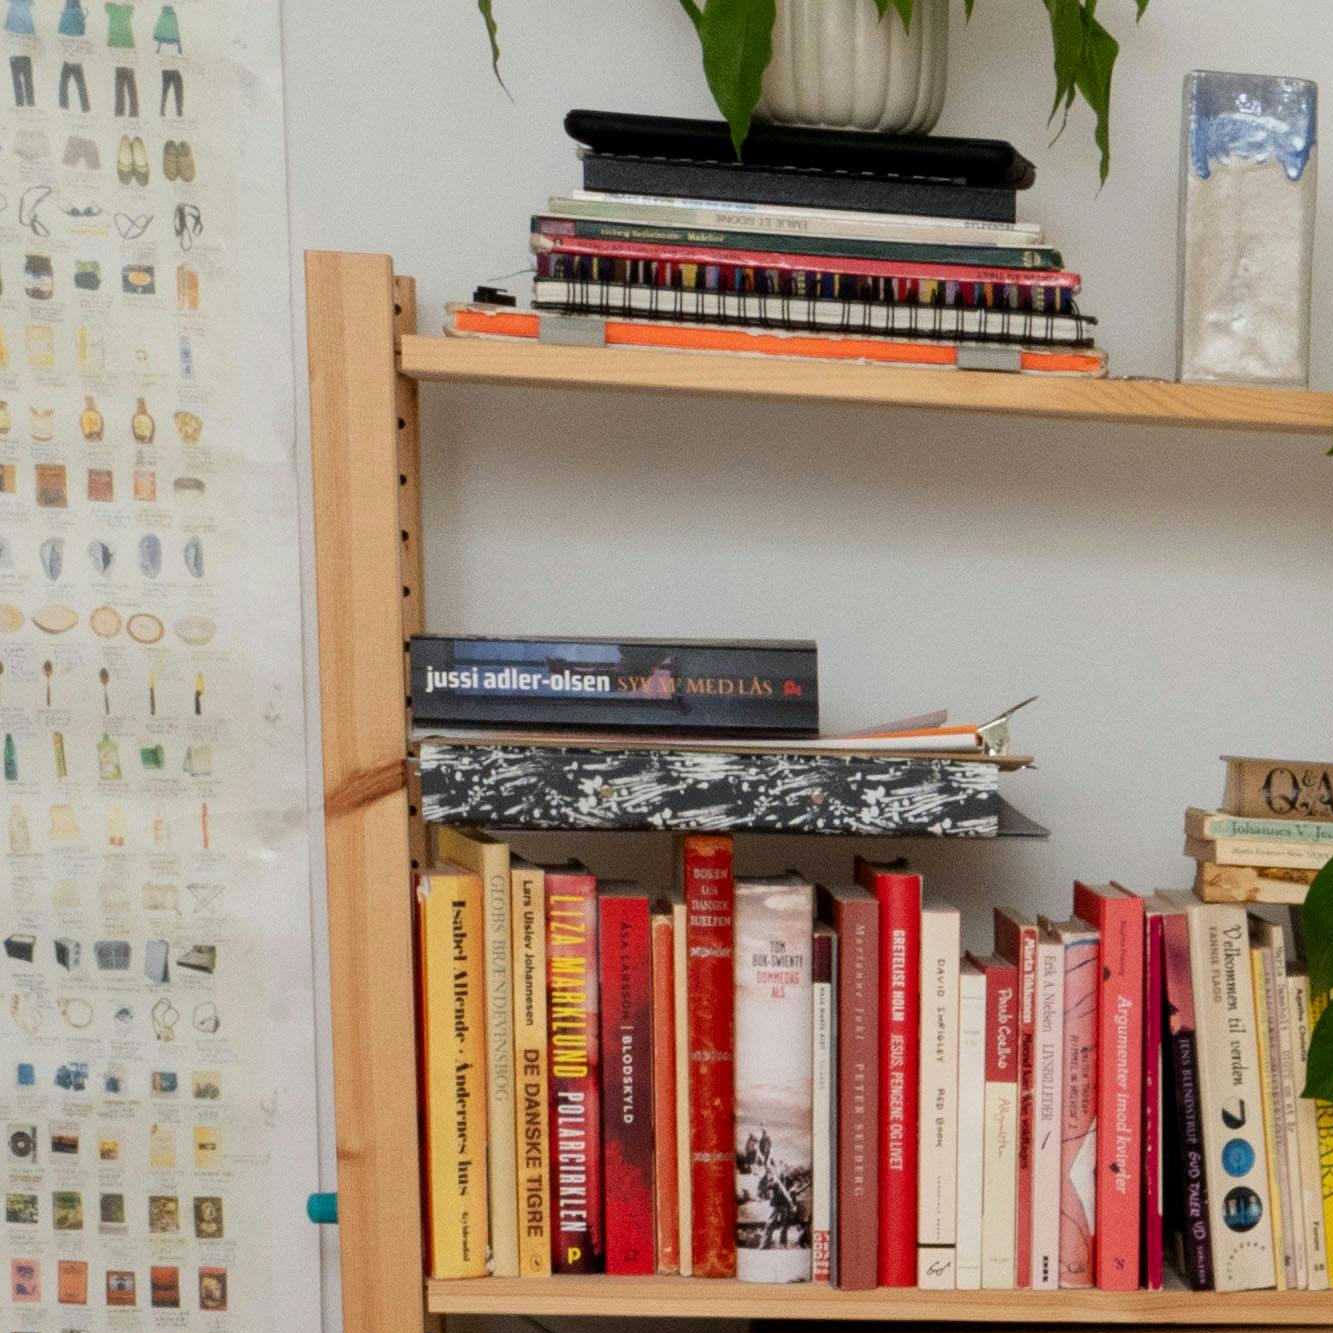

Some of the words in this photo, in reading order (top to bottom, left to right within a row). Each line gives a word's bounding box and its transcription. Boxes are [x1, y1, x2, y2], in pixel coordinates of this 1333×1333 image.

[426, 666, 478, 692] jussi
[484, 670, 610, 691] adler-olsen
[687, 678, 733, 694] MED
[1232, 822, 1292, 837] Johannes
[523, 880, 534, 907] Lars
[452, 900, 467, 961] Isabel
[550, 895, 587, 945] LIZA
[893, 929, 905, 986] GRETELISE
[1222, 926, 1241, 1010] Velkommen
[454, 967, 469, 1043] Allende
[551, 957, 587, 1078] MARKLUND
[893, 991, 905, 1021] HOLM
[1042, 994, 1055, 1032] Nielsen
[1229, 1019, 1244, 1033] til
[523, 1049, 540, 1076] DE
[1116, 995, 1132, 1088] Argumenter
[1230, 1041, 1245, 1086] verden
[622, 1035, 634, 1124] BLODSKYLD
[890, 1072, 904, 1120] PENGENE
[524, 1084, 542, 1169] DANSKE
[891, 1124, 903, 1139] OG
[1116, 1093, 1130, 1132] imod
[457, 1161, 473, 1196] hus
[557, 1091, 586, 1232] POLARCIRKLEN
[890, 1142, 902, 1170] LIVET
[1115, 1136, 1130, 1194] kvinder
[526, 1176, 543, 1237] TIGRE
